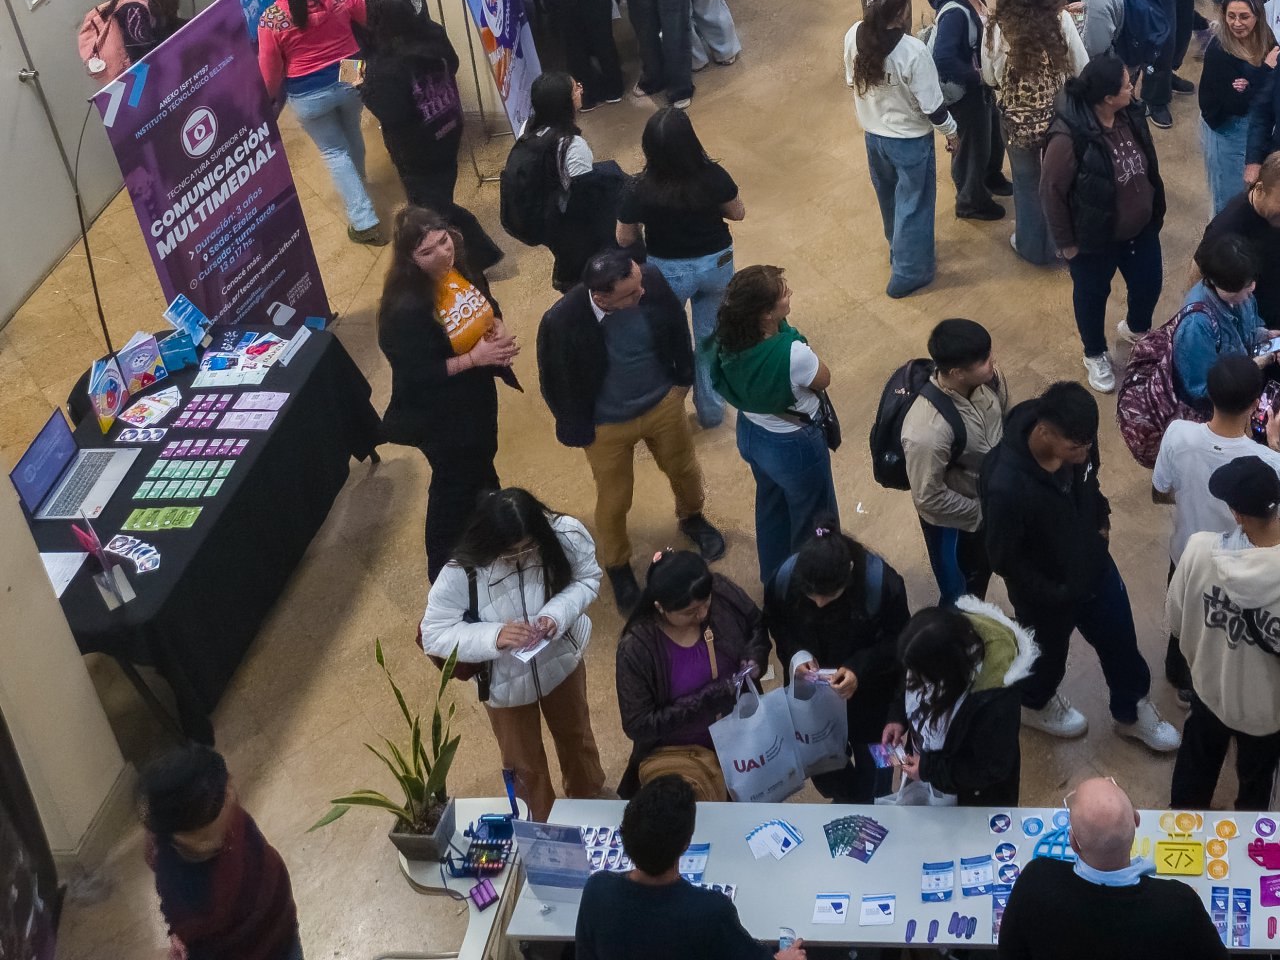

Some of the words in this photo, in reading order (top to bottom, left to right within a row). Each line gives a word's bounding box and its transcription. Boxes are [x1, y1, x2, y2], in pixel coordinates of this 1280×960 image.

[135, 110, 168, 140] INSTITUTO
[168, 76, 210, 113] TECNOLÓGICO
[159, 88, 180, 110] ANEXO
[179, 77, 193, 91] ISFT
[151, 122, 270, 238] COMUNICACIÓN
[166, 161, 211, 200] TECNICATURA
[210, 134, 239, 162] SUPERIOR
[238, 125, 248, 137] EN
[155, 142, 276, 260] MULTIMEDIAL
[195, 212, 236, 255] Duración:
[236, 205, 242, 215] 3
[242, 186, 263, 209] años
[208, 230, 233, 257] Sede:
[232, 206, 258, 235] Ezeiza
[198, 243, 235, 281] Cursada:
[234, 223, 257, 247] turno
[255, 203, 276, 225] tarde
[220, 262, 229, 273] 13
[235, 247, 242, 258] 17
[221, 268, 247, 296] Conocé
[246, 253, 262, 272] más:
[733, 754, 766, 773] UAI
